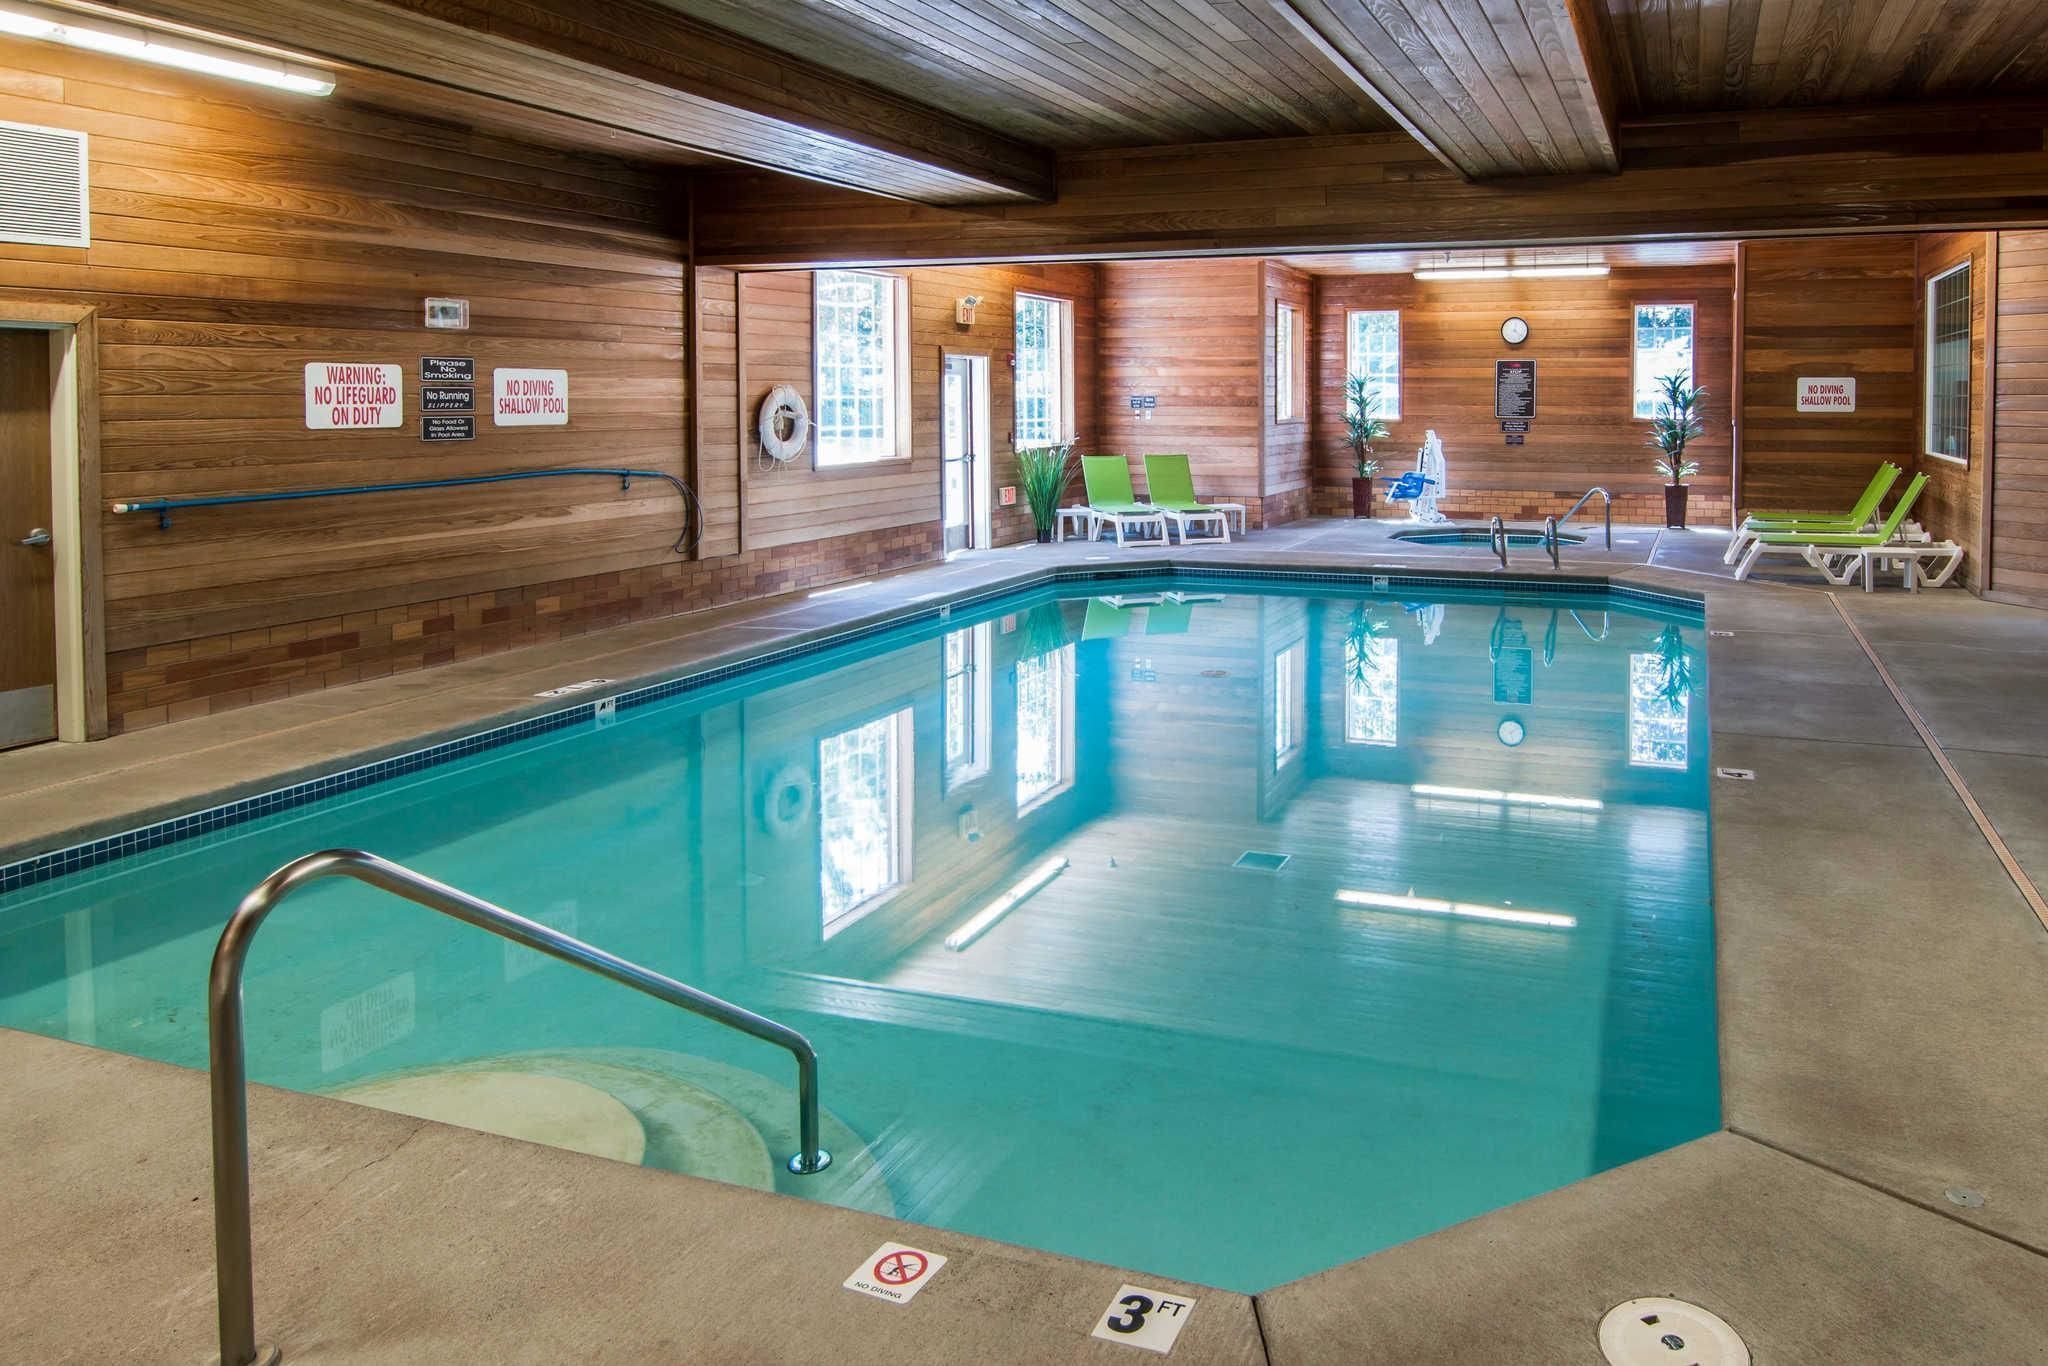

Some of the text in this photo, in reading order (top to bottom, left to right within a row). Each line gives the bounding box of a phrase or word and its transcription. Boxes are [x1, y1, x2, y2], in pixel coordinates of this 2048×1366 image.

[326, 366, 386, 385] WARNING:
[424, 372, 472, 380] Smoking
[314, 386, 396, 405] NO LIFEGUARD
[506, 380, 554, 396] NO DIVING
[1807, 385, 1844, 394] NO DIVING
[426, 391, 470, 402] No Running
[1801, 396, 1851, 405] SHALLOW POOL
[499, 398, 566, 414] SHALLOW POOL
[332, 407, 381, 425] ON DUTY
[854, 1281, 903, 1299] NO DIVING
[1107, 1294, 1187, 1333] 3 FT
